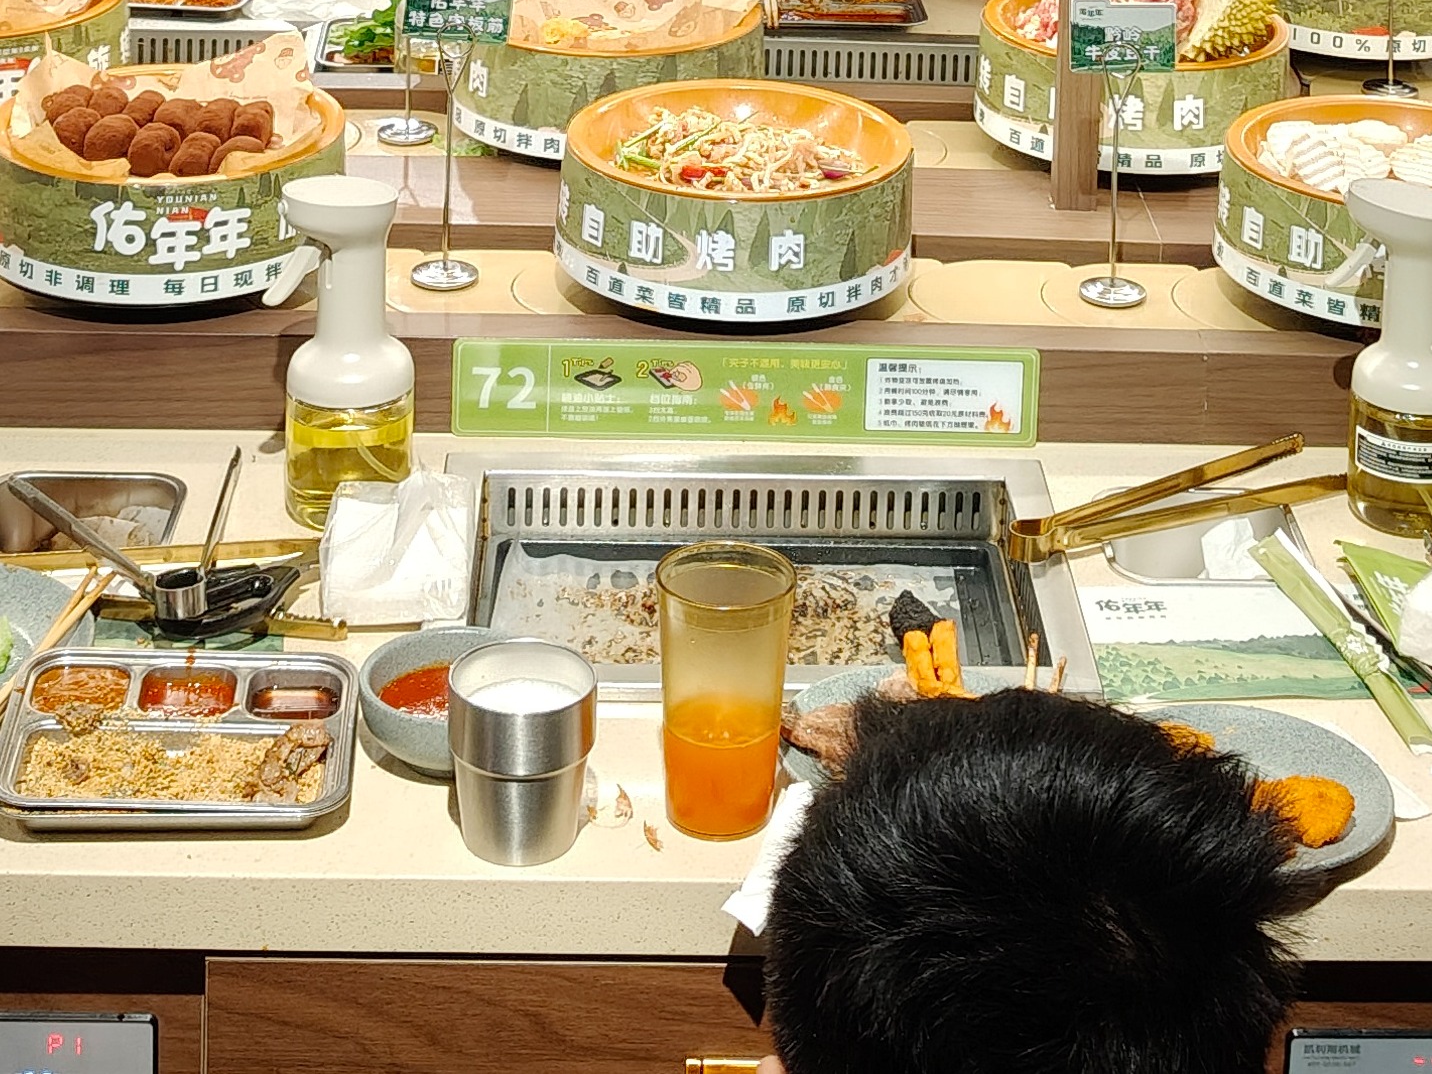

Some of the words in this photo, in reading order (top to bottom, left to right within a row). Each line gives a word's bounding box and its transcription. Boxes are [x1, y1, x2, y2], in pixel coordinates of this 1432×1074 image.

[156, 193, 218, 204] YOUNIAN
[156, 206, 189, 216] NIAN
[90, 200, 251, 271] 佑年年
[0, 249, 131, 297] 原切非调理
[163, 261, 283, 296] 每日现拌
[585, 264, 757, 316] 百道菜皆精品
[471, 366, 537, 410] 72
